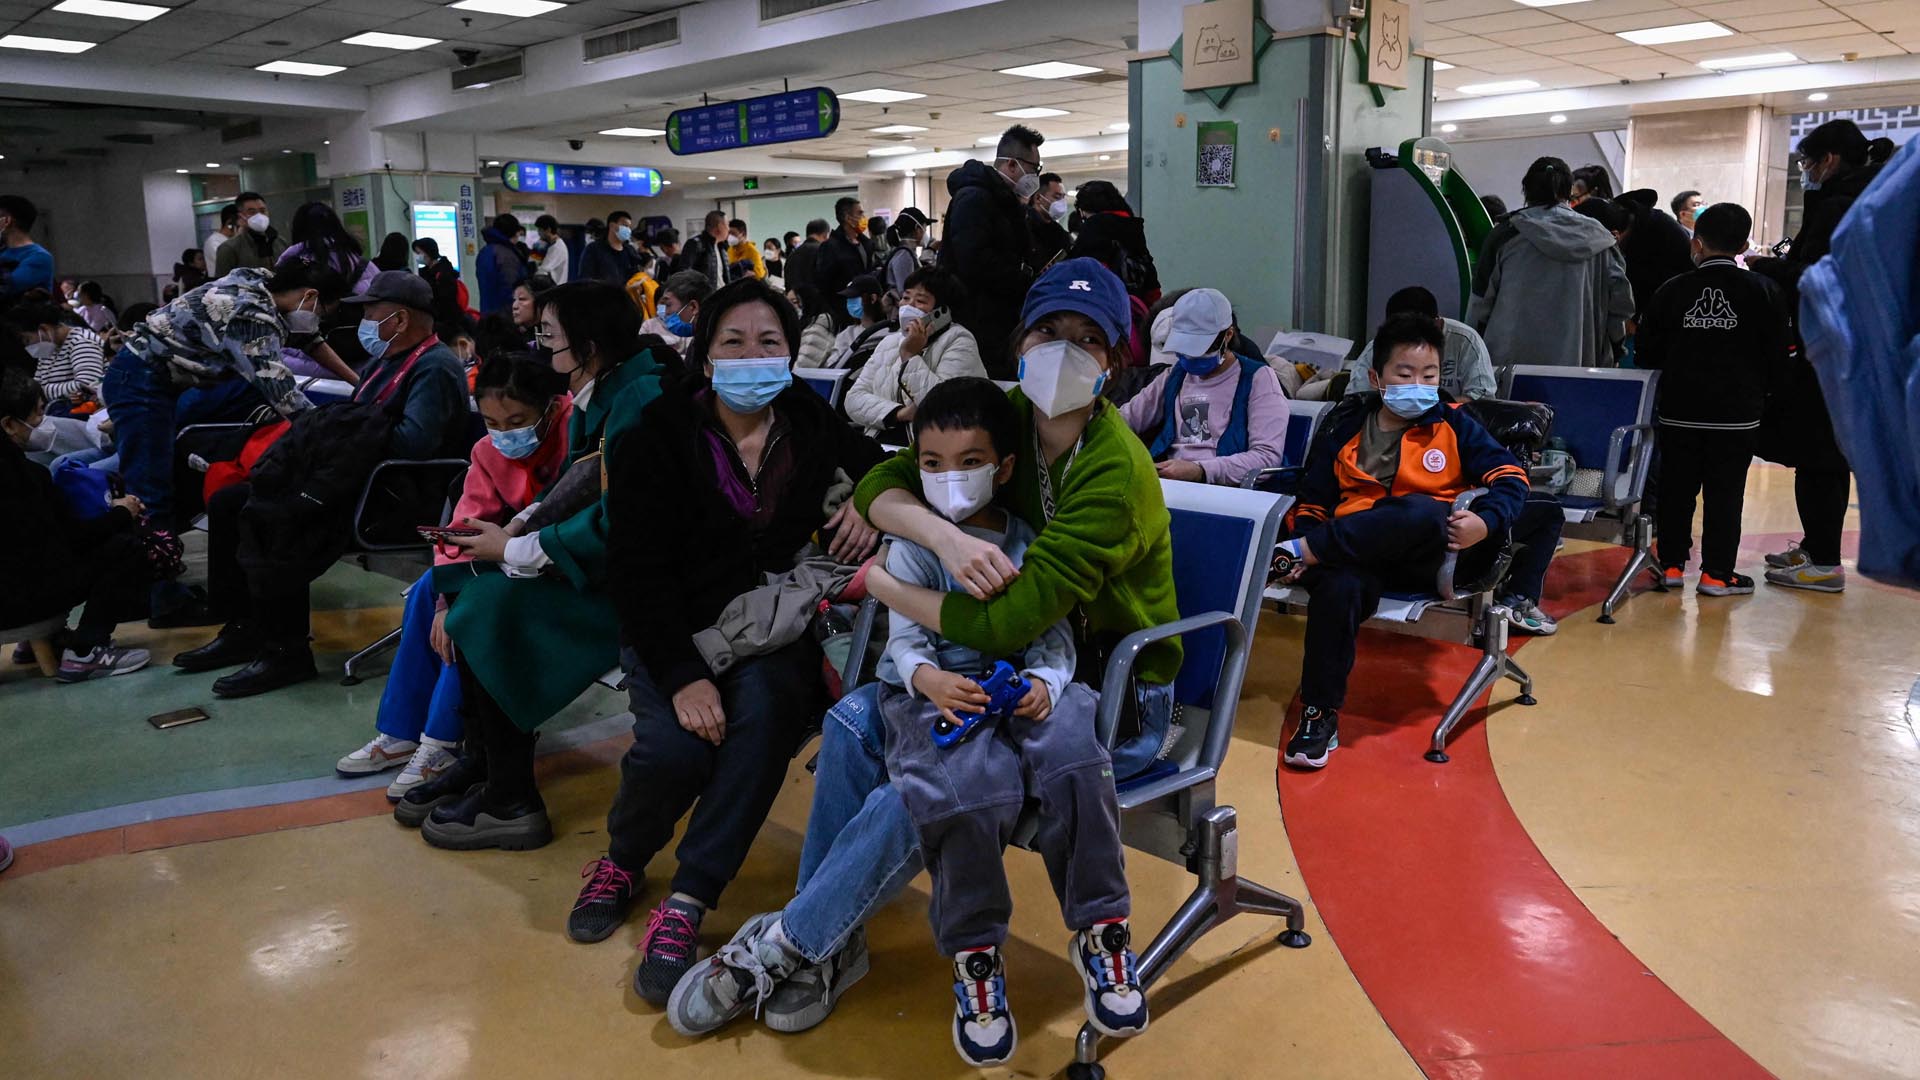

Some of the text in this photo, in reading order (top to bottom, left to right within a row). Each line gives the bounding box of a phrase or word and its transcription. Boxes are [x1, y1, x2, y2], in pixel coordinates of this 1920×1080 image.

[460, 184, 475, 239] 自助报到
[1069, 280, 1091, 292] R
[1683, 317, 1738, 330] Kapap
